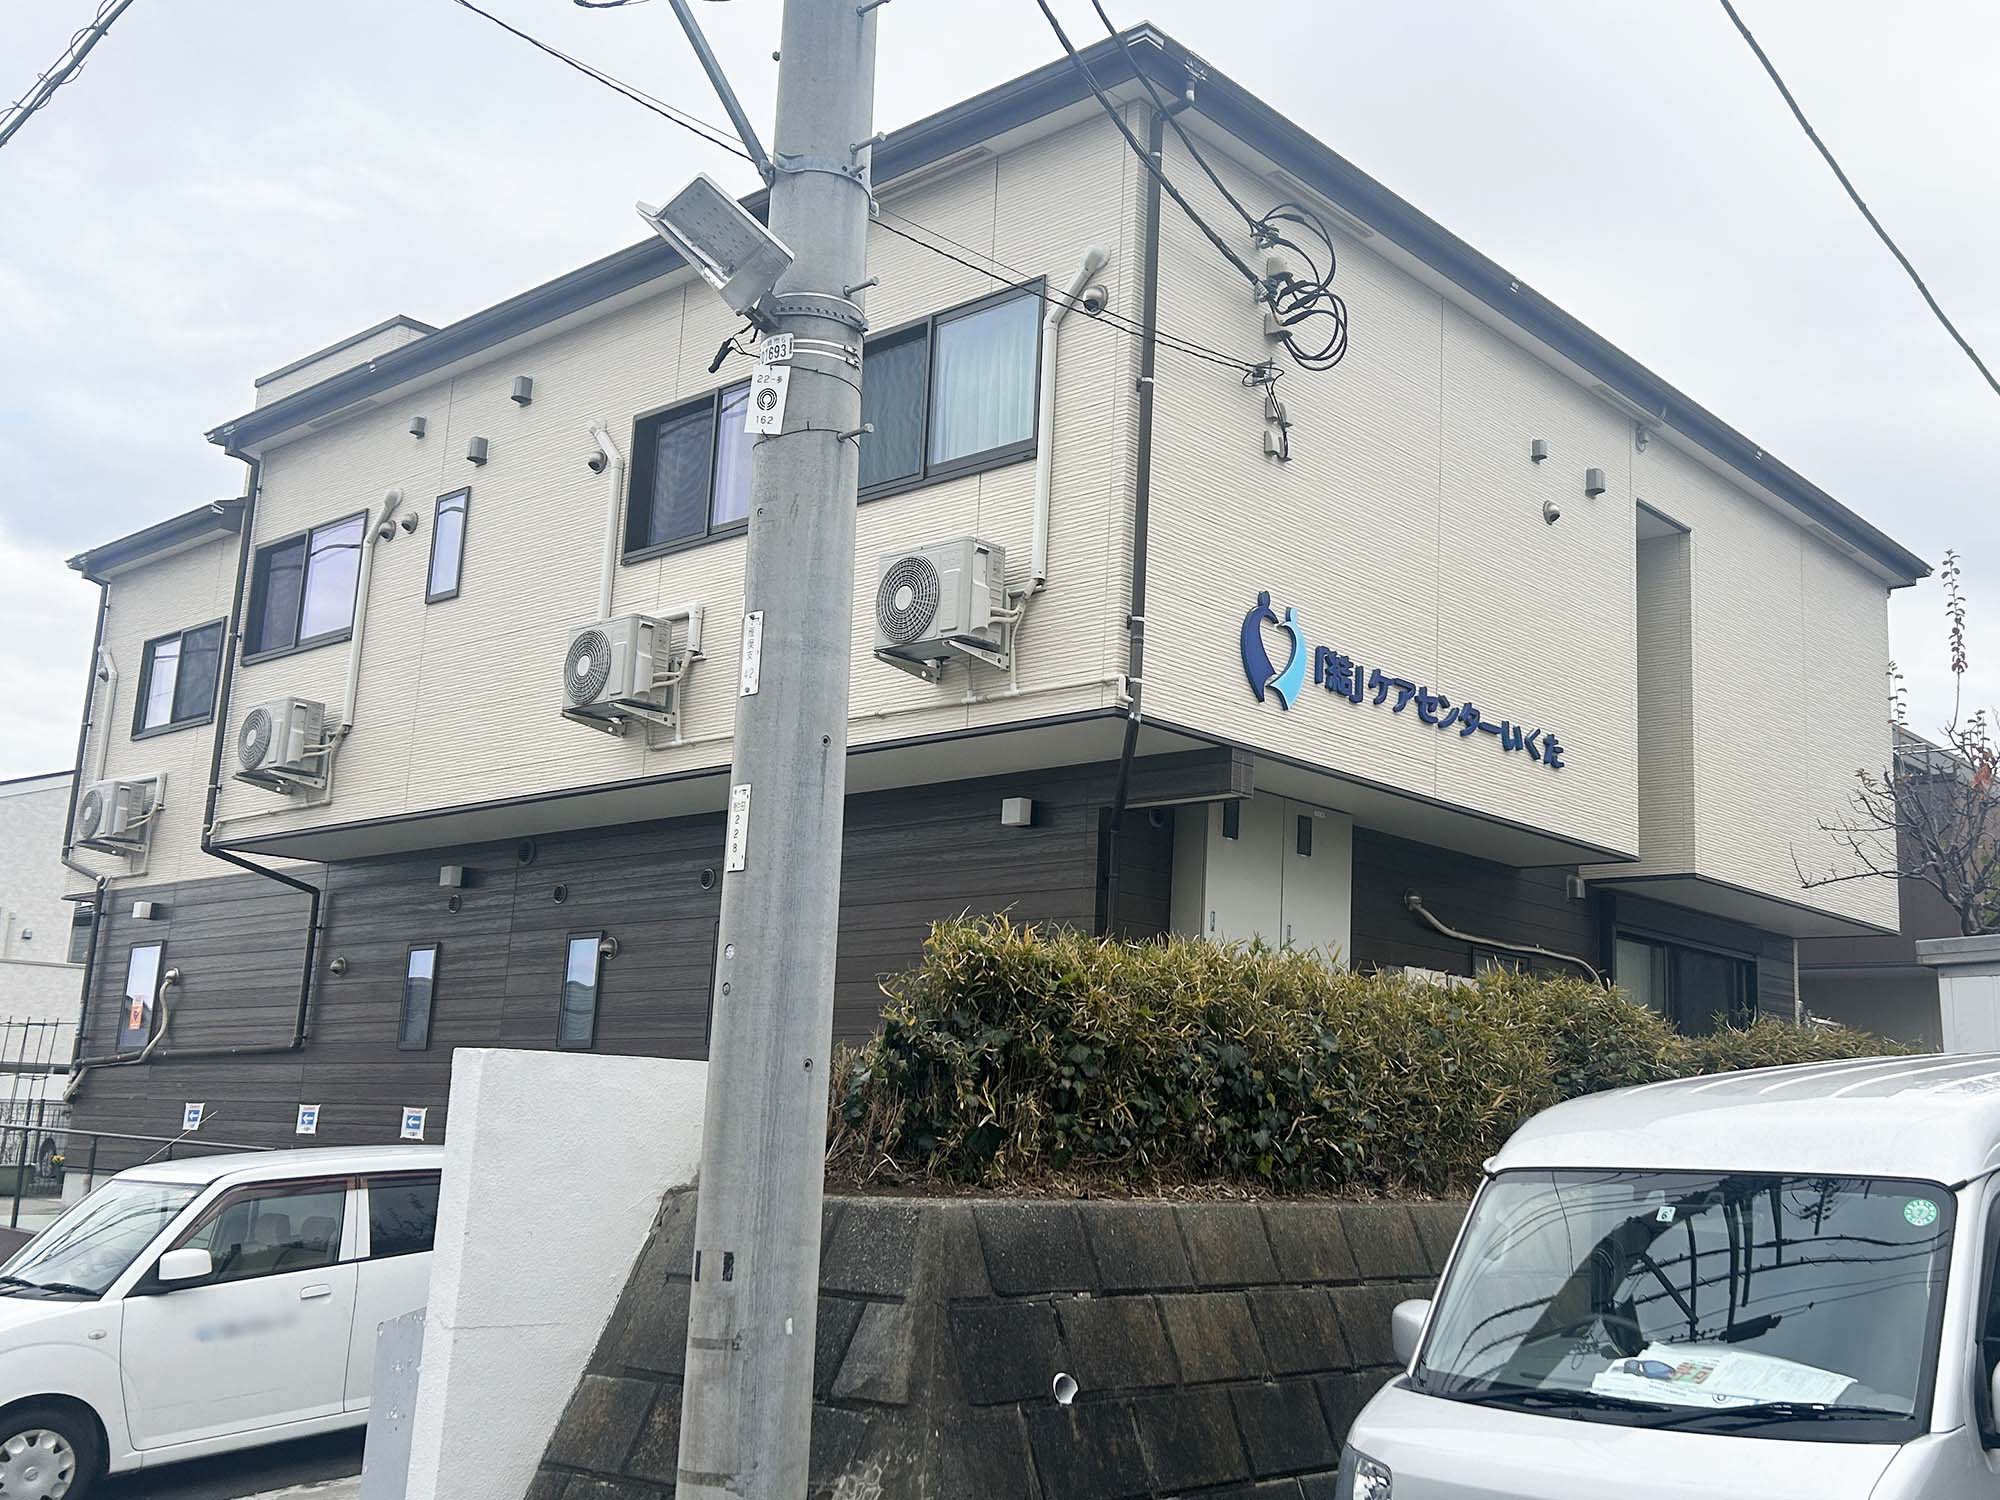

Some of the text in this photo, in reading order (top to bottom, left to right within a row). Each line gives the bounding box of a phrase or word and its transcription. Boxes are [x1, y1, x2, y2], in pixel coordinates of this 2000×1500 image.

[756, 415, 774, 425] 162
[1314, 645, 1565, 769] 「結」ケアセンターいくた
